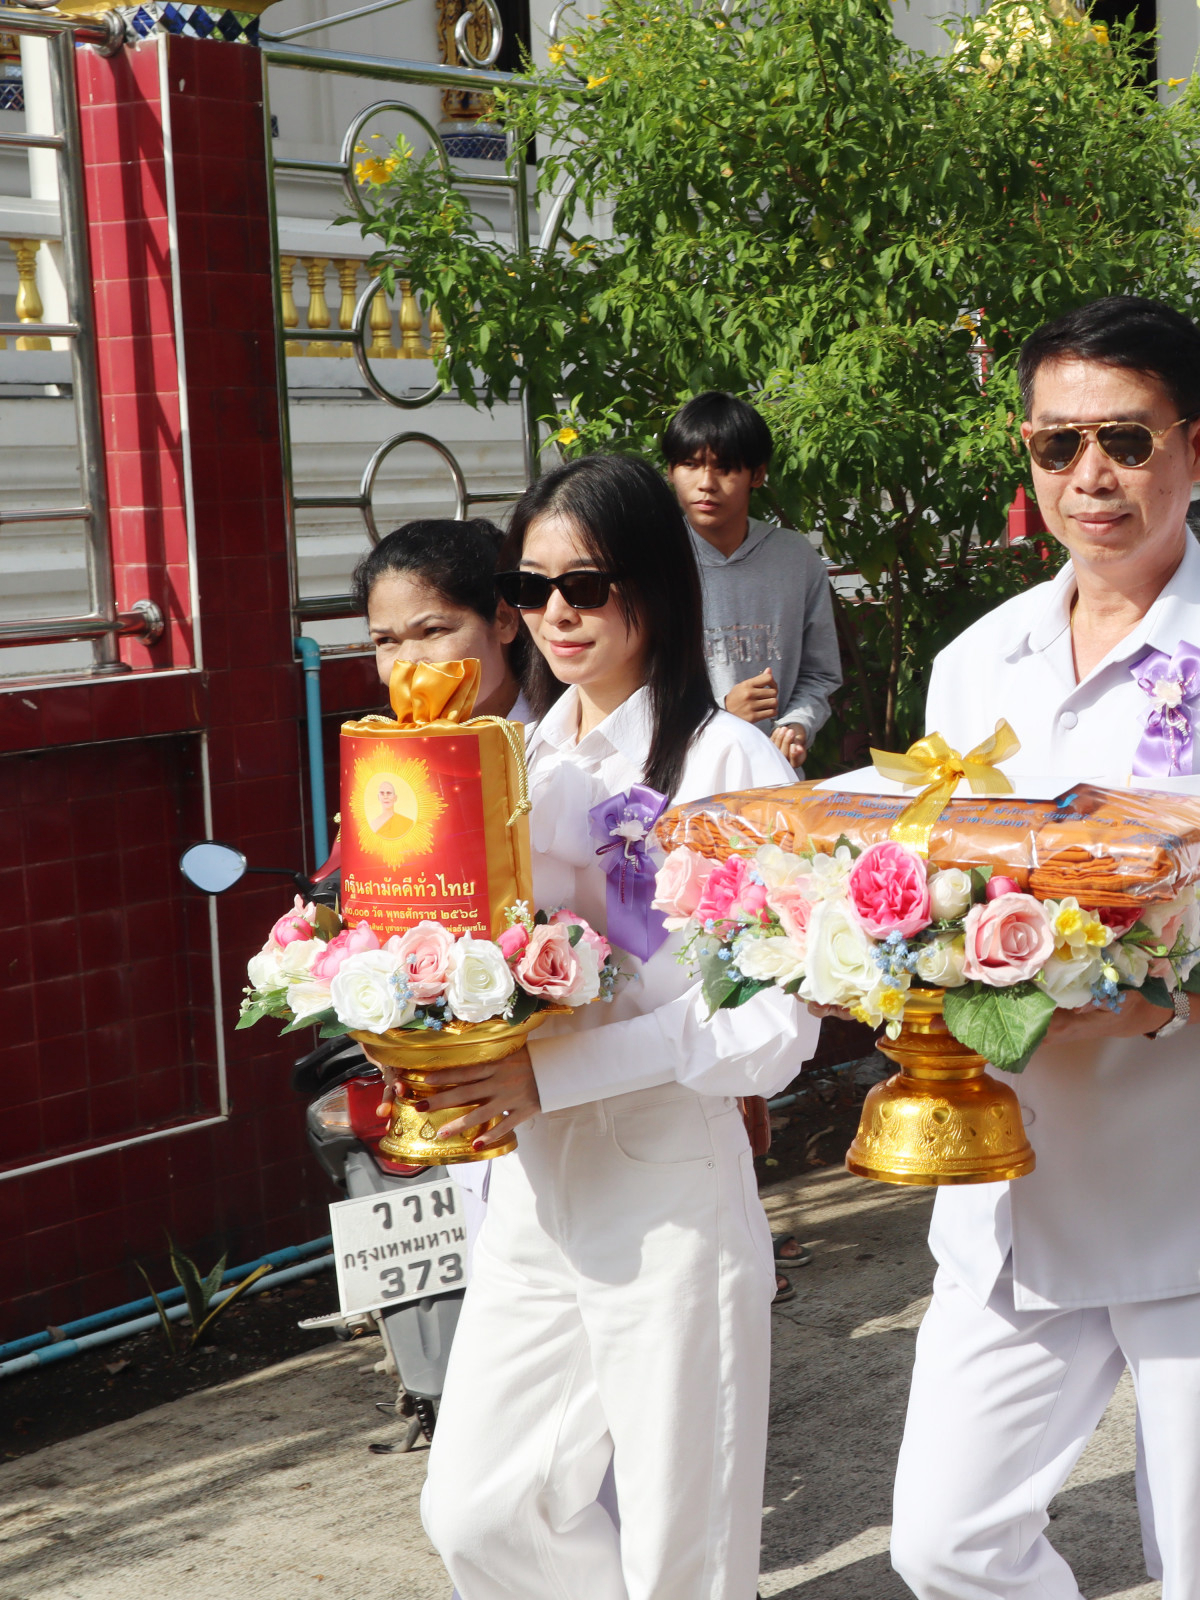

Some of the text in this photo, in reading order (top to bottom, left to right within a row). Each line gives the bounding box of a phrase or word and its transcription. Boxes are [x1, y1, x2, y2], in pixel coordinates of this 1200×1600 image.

[373, 1186, 455, 1230] ววม
[344, 1226, 465, 1271] กรุงเทพมหาน
[380, 1252, 464, 1299] 373
